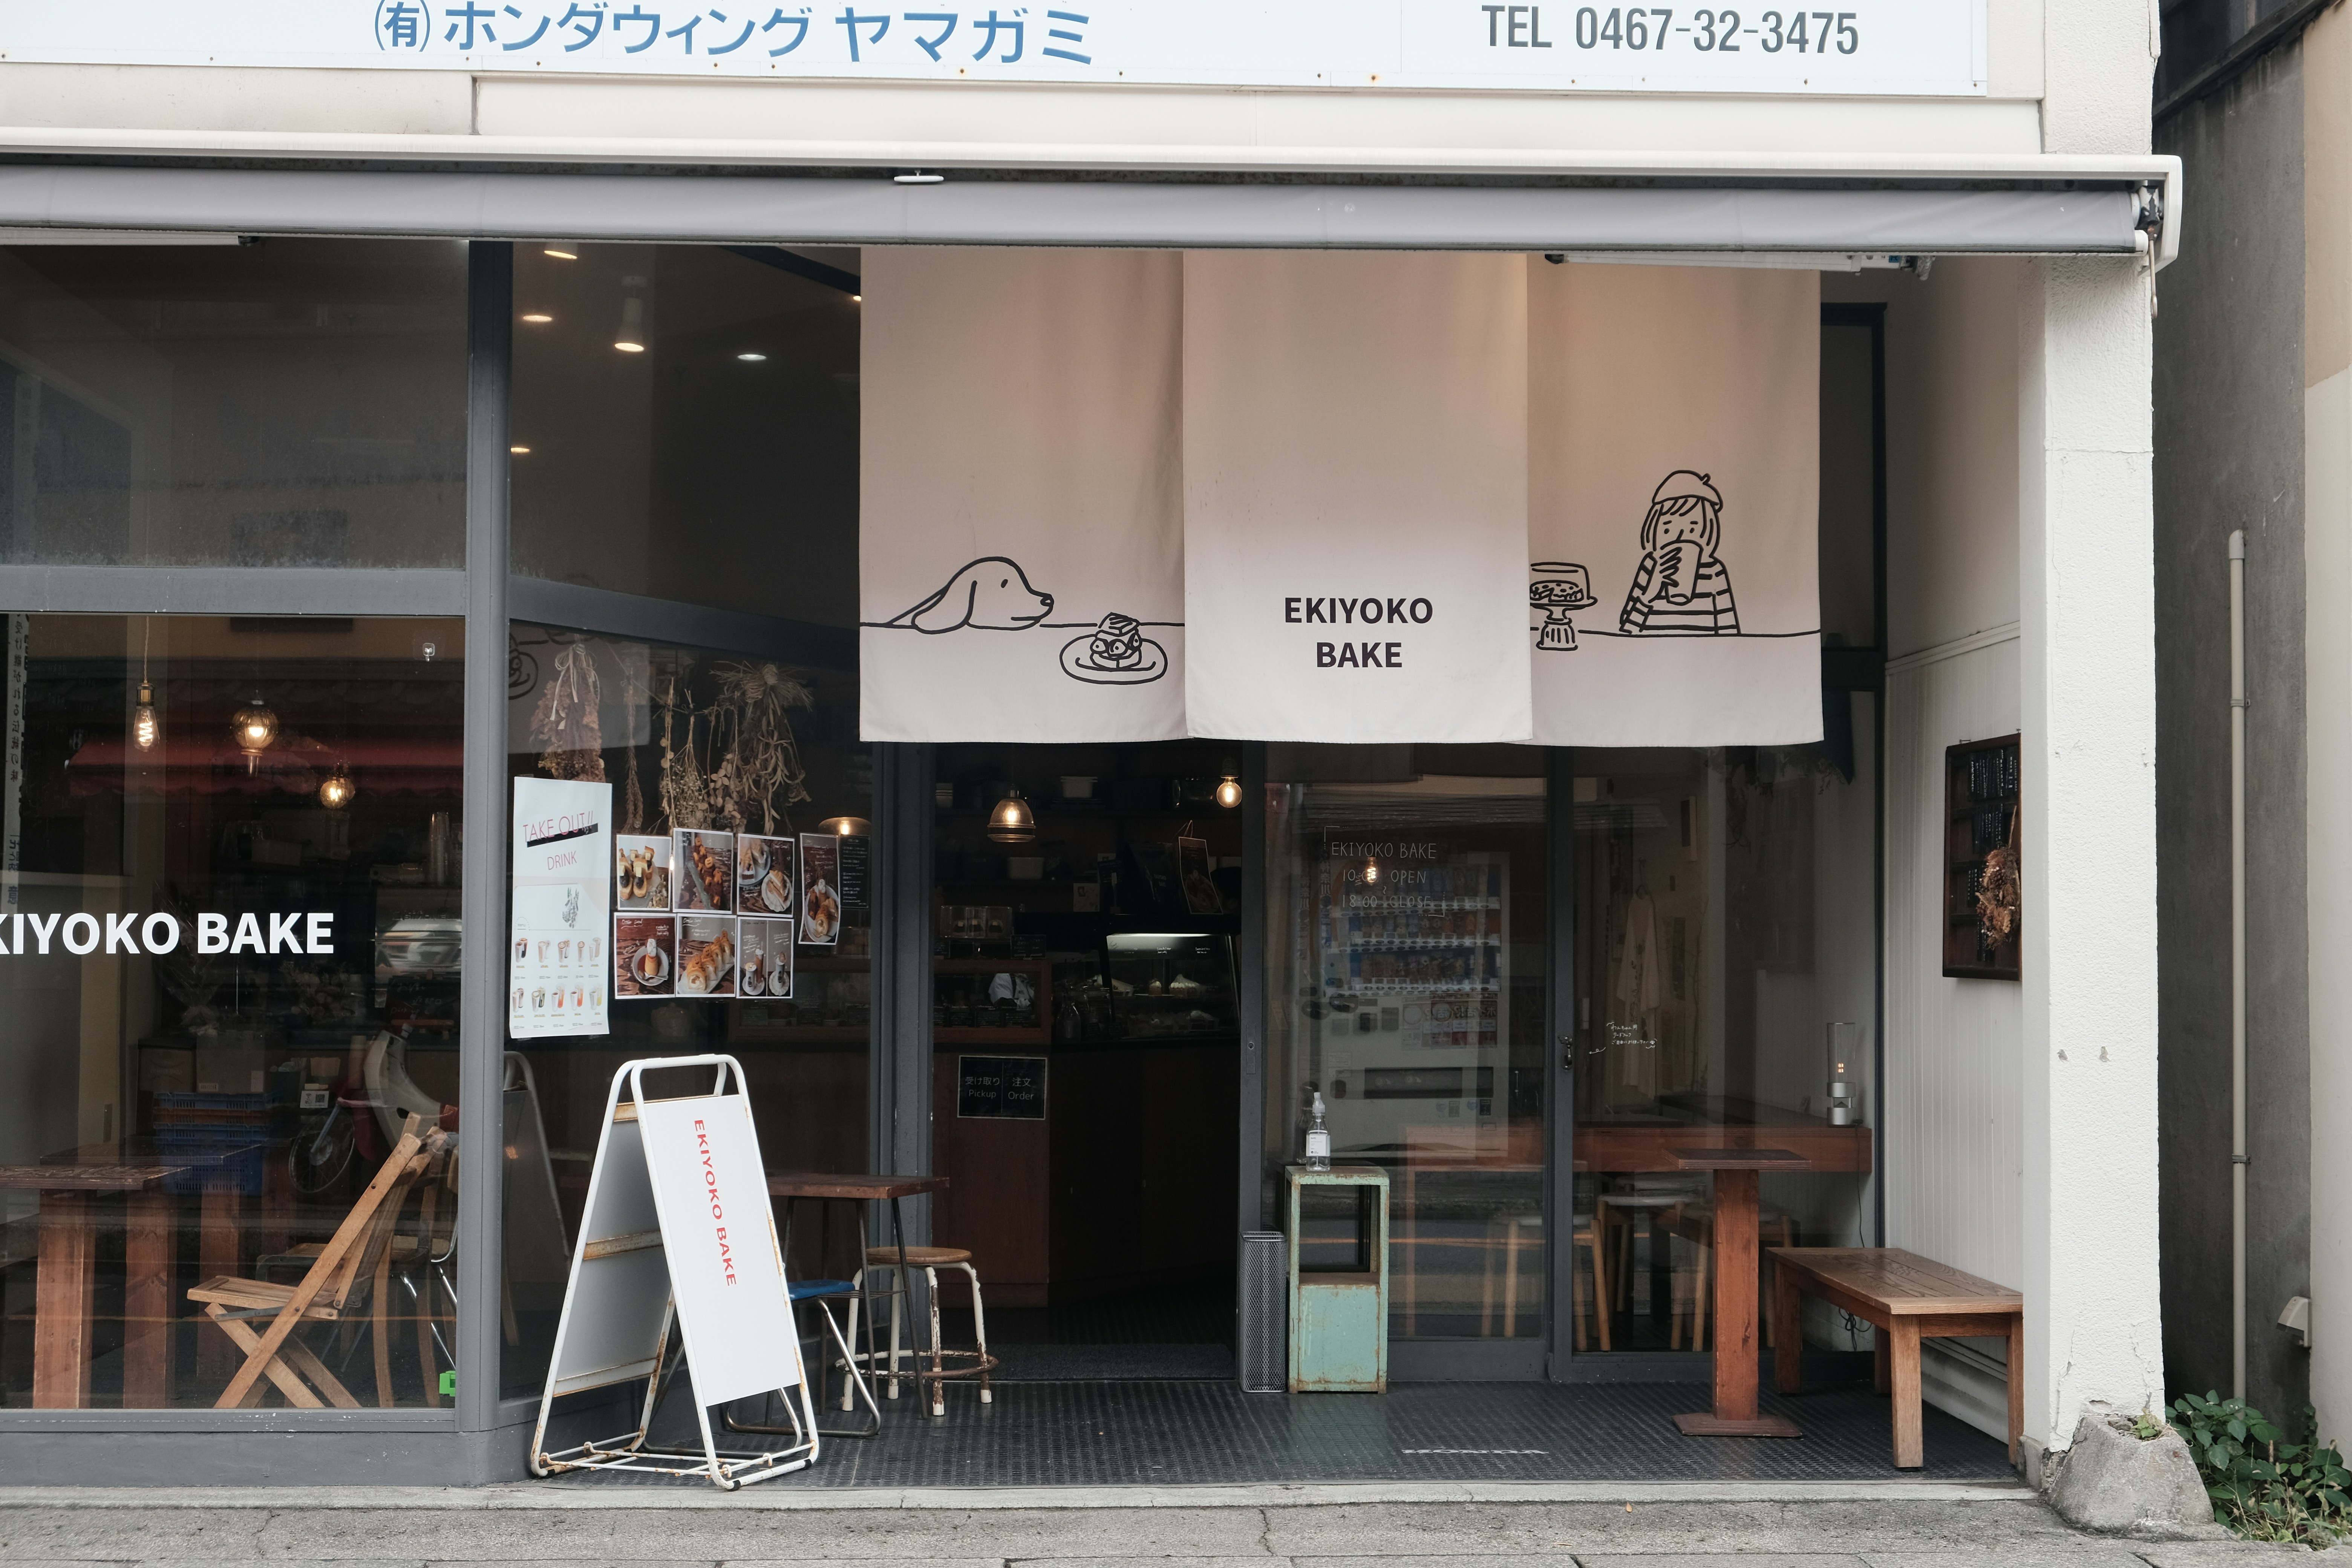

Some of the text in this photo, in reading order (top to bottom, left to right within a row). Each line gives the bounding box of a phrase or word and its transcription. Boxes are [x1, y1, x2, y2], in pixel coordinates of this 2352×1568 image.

[835, 6, 1092, 65] ヤマガミ
[1481, 5, 1859, 55] TEL 0467-32-3475
[1285, 597, 1433, 624] EKIYOKO
[1316, 642, 1403, 668] BAKE
[523, 819, 554, 843] TAKE
[547, 850, 577, 870] DRINK
[1331, 842, 1437, 859] EKIYOKO BAKE
[1390, 869, 1427, 885] OPEN
[1343, 894, 1431, 908] 18:00 CLOSE
[197, 913, 334, 954] BAKE
[965, 1076, 1000, 1086] 受け取り
[1012, 1077, 1032, 1087] 注文
[969, 1089, 997, 1099] Pickup
[1008, 1091, 1035, 1100] Order
[694, 1119, 723, 1220] EKIYOKO
[716, 1227, 737, 1286] BAKE
